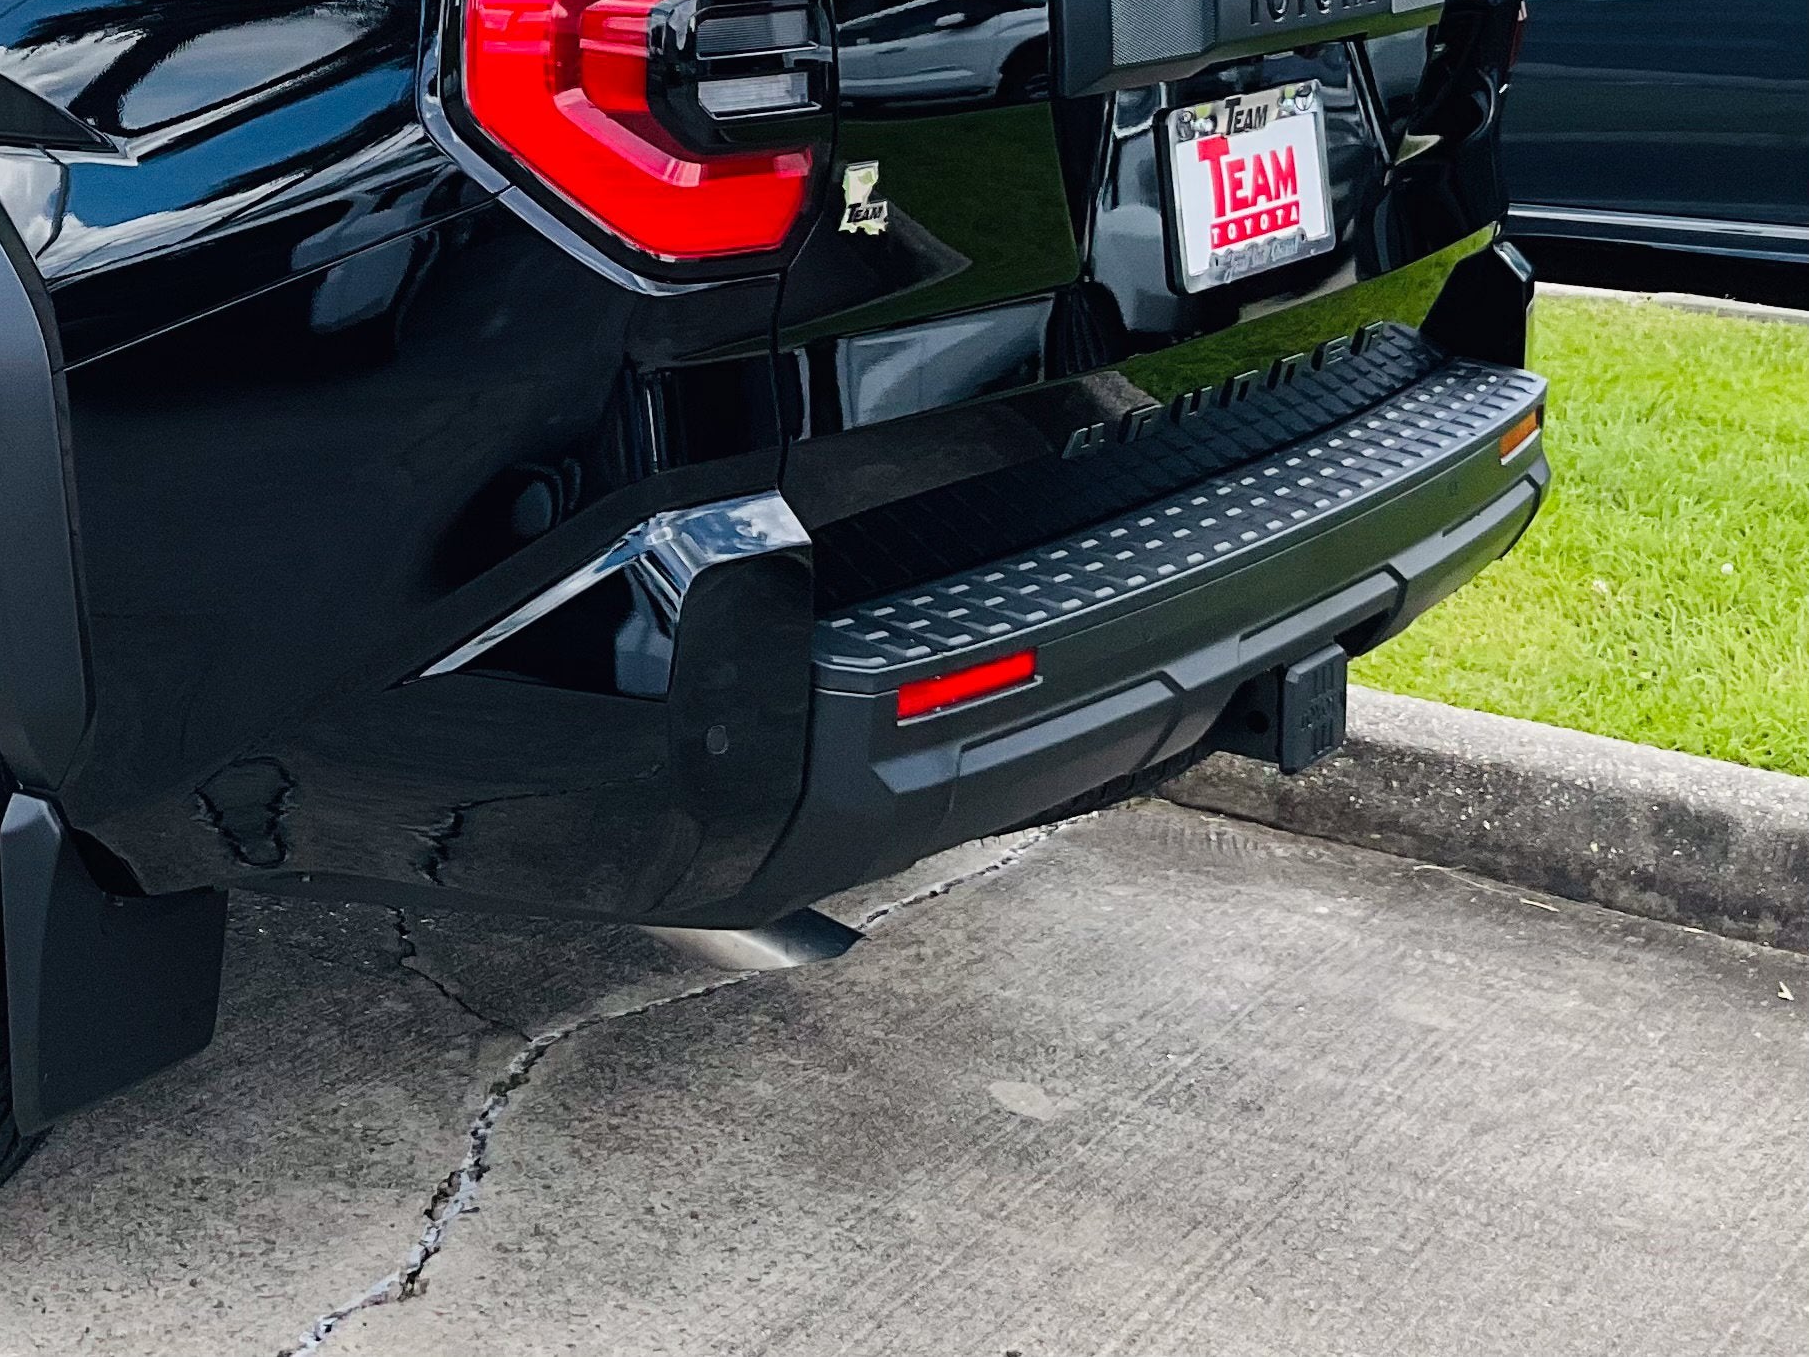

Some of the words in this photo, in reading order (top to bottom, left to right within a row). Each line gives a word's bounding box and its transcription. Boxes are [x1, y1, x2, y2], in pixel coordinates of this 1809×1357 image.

[1224, 96, 1269, 136] TEAM
[1197, 134, 1299, 219] TEAM
[1211, 203, 1299, 244] TOYOTA
